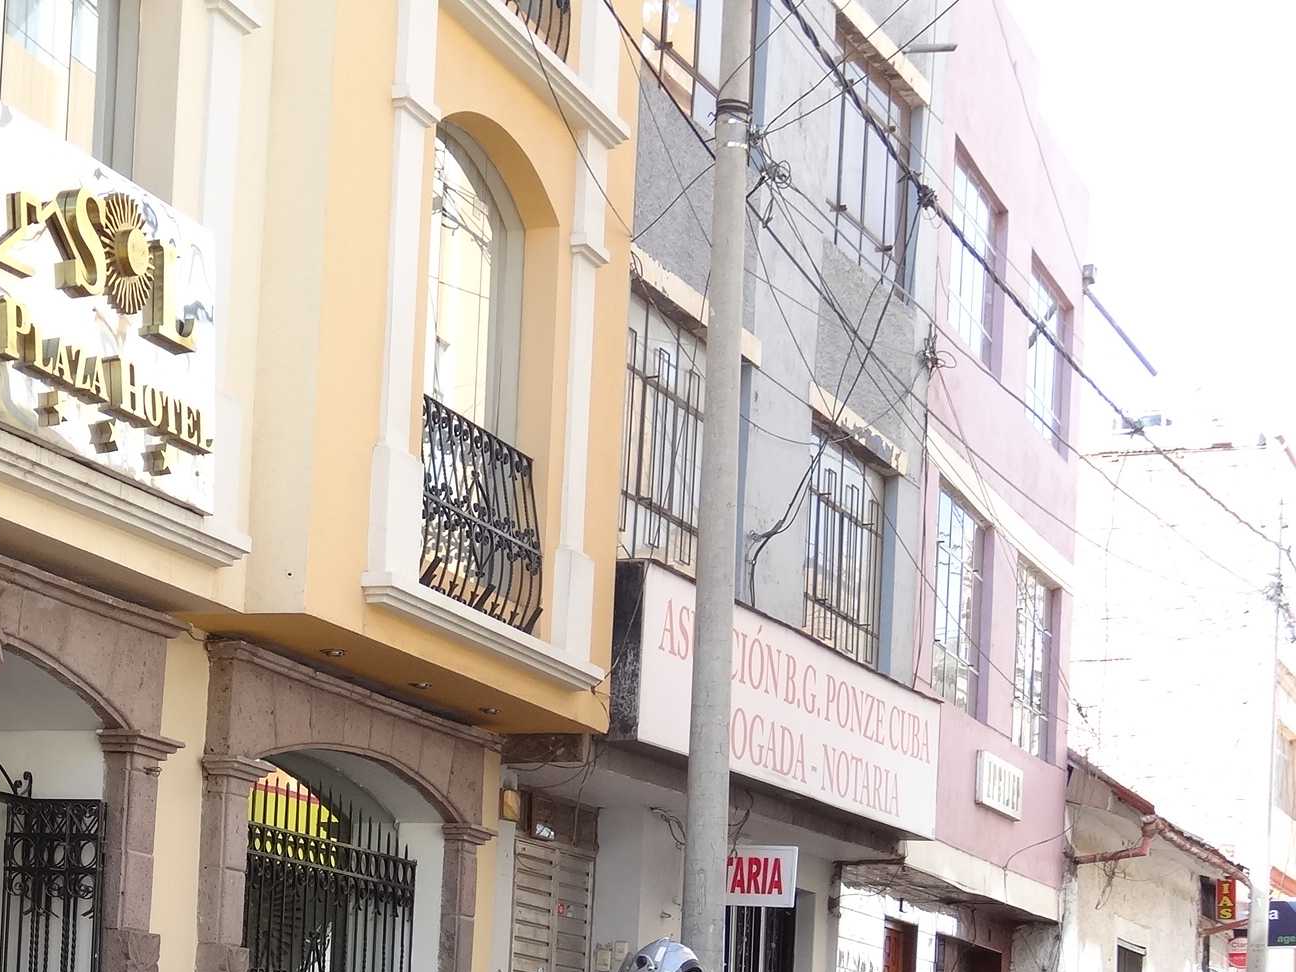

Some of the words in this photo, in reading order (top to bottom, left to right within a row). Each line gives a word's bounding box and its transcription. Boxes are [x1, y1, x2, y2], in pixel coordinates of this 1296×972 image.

[106, 357, 215, 455] HOTEL
[728, 707, 808, 785] OGADA
[821, 744, 901, 818] NOTARIA
[824, 674, 886, 746] PONZE
[888, 705, 932, 764] CUBA
